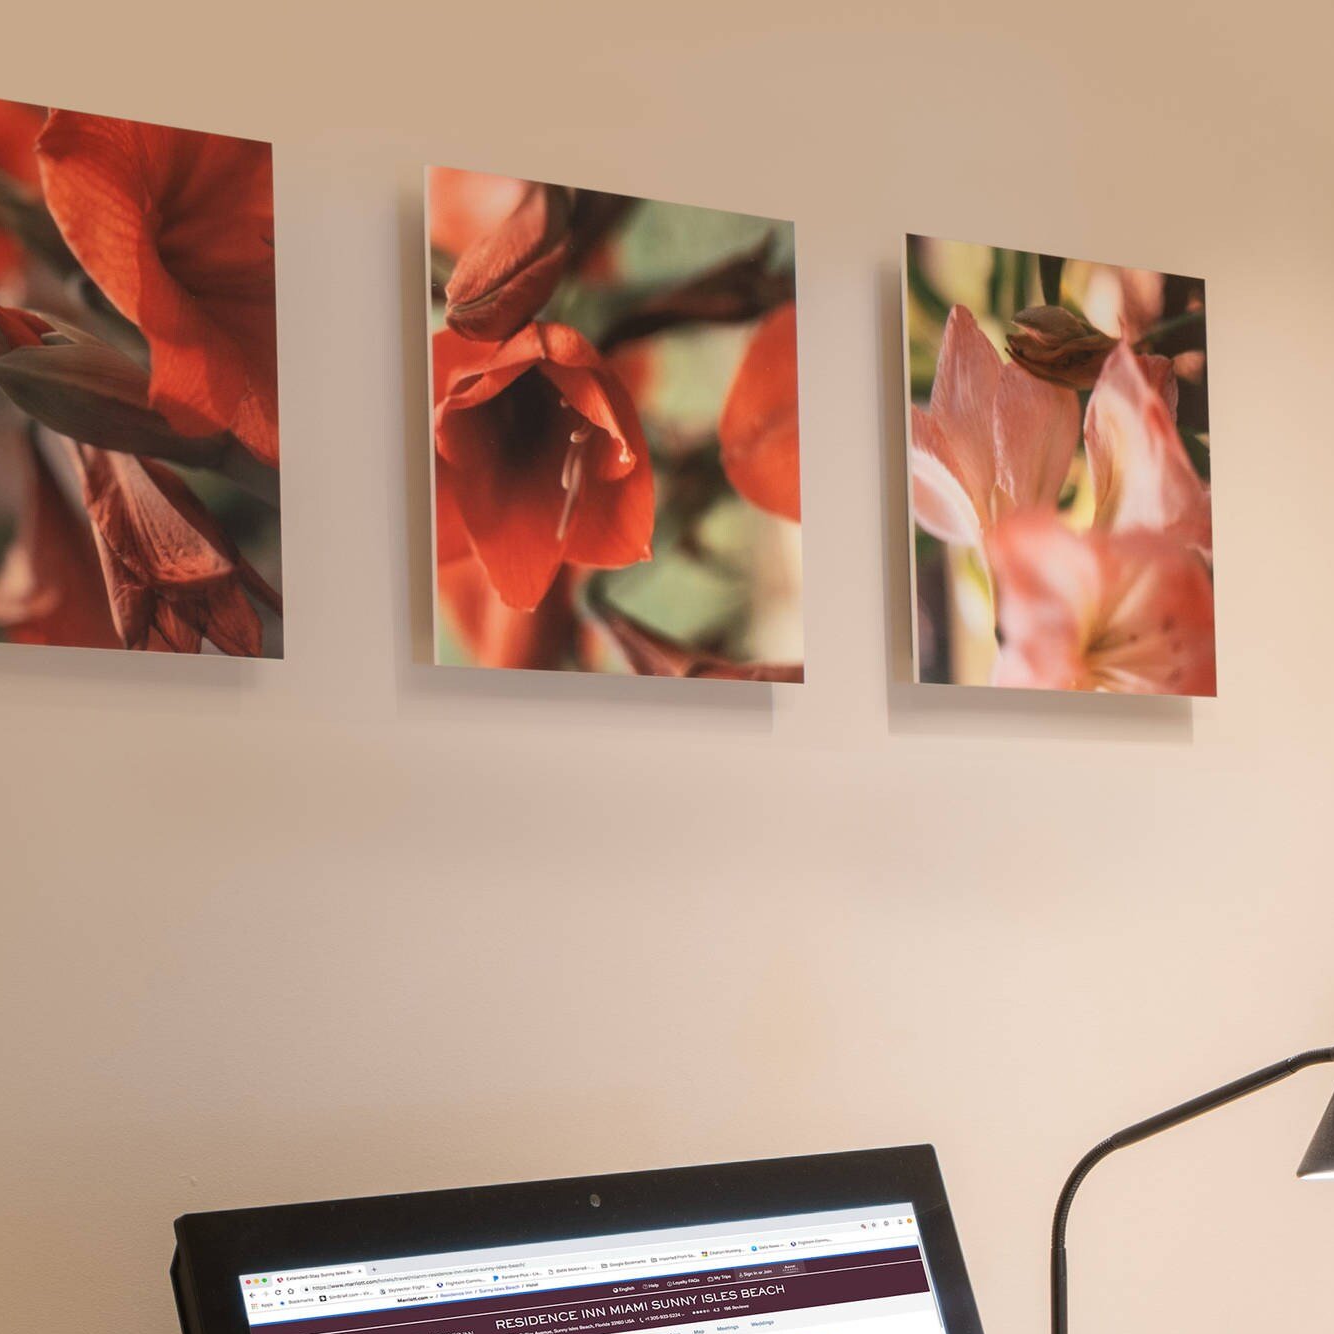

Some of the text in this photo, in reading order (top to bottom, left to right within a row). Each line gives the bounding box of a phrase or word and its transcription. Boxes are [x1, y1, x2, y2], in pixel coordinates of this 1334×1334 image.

[396, 1295, 431, 1303] Marriott.com
[494, 1284, 785, 1330] RESIDENCE INN MIAMI SUNNY ISLES BEACH
[715, 1324, 740, 1332] Meetings
[749, 1320, 775, 1328] Weddings
